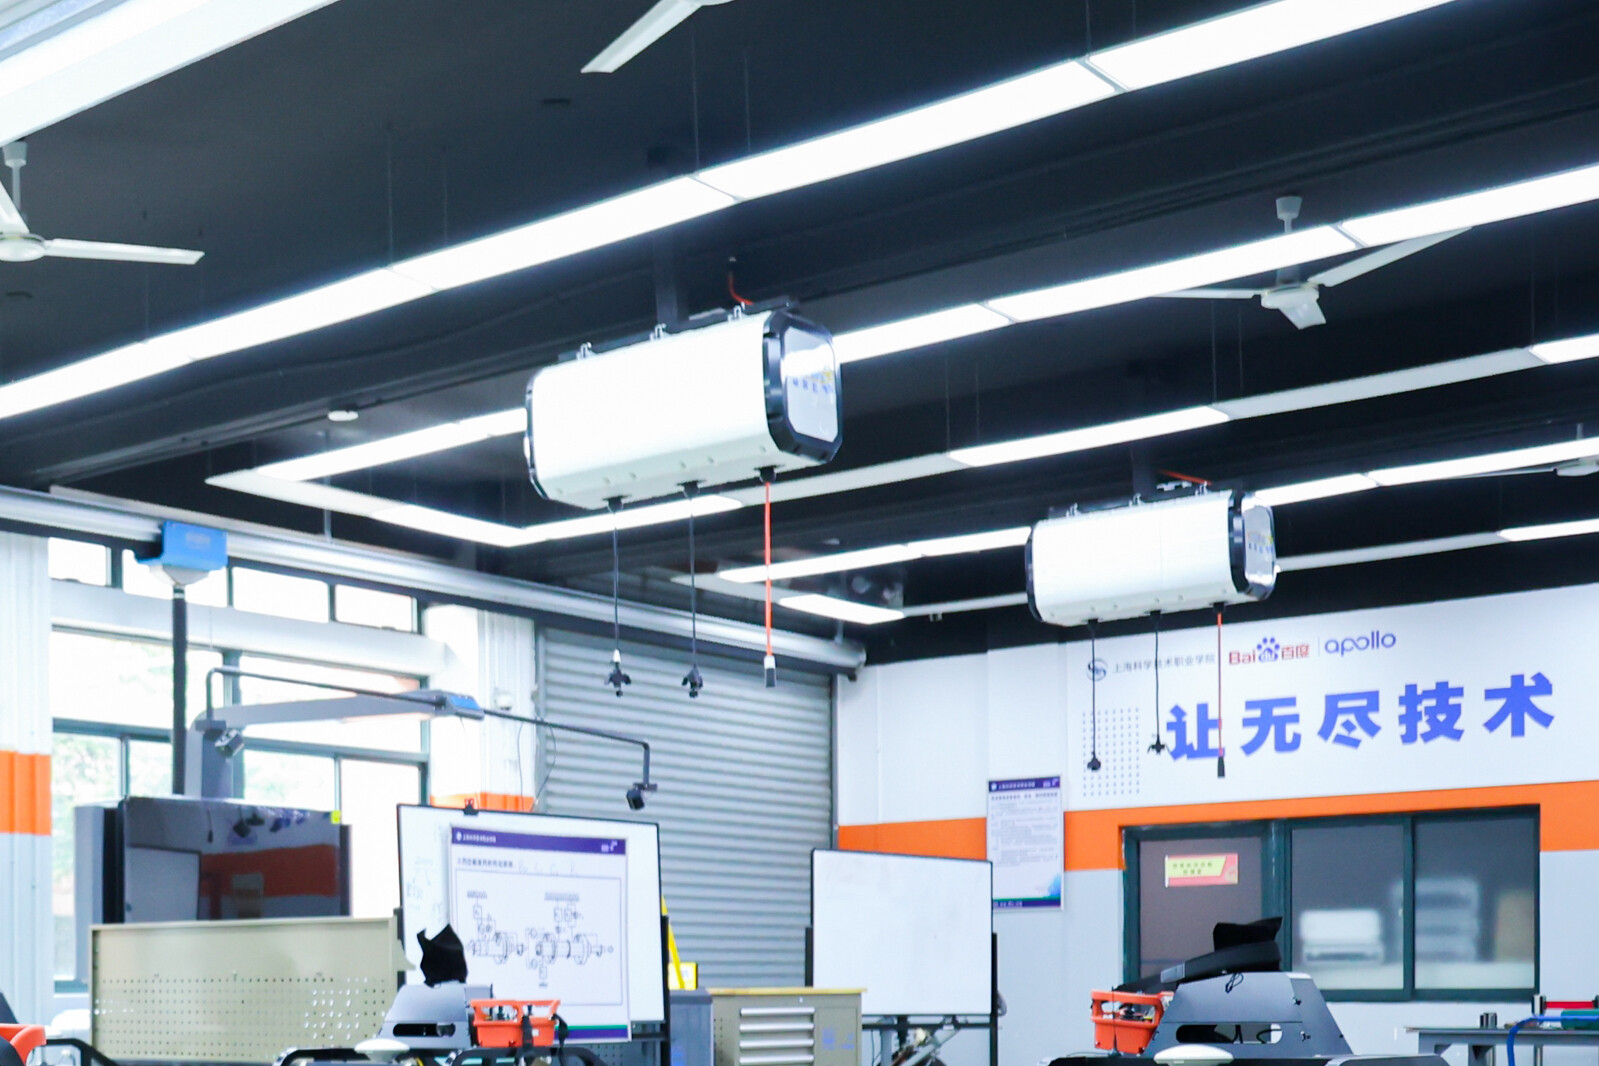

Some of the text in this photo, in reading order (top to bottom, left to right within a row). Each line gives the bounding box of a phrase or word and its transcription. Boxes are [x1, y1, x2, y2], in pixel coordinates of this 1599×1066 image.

[1324, 630, 1397, 657] apollo
[1166, 672, 1555, 761] 让无尽技术
